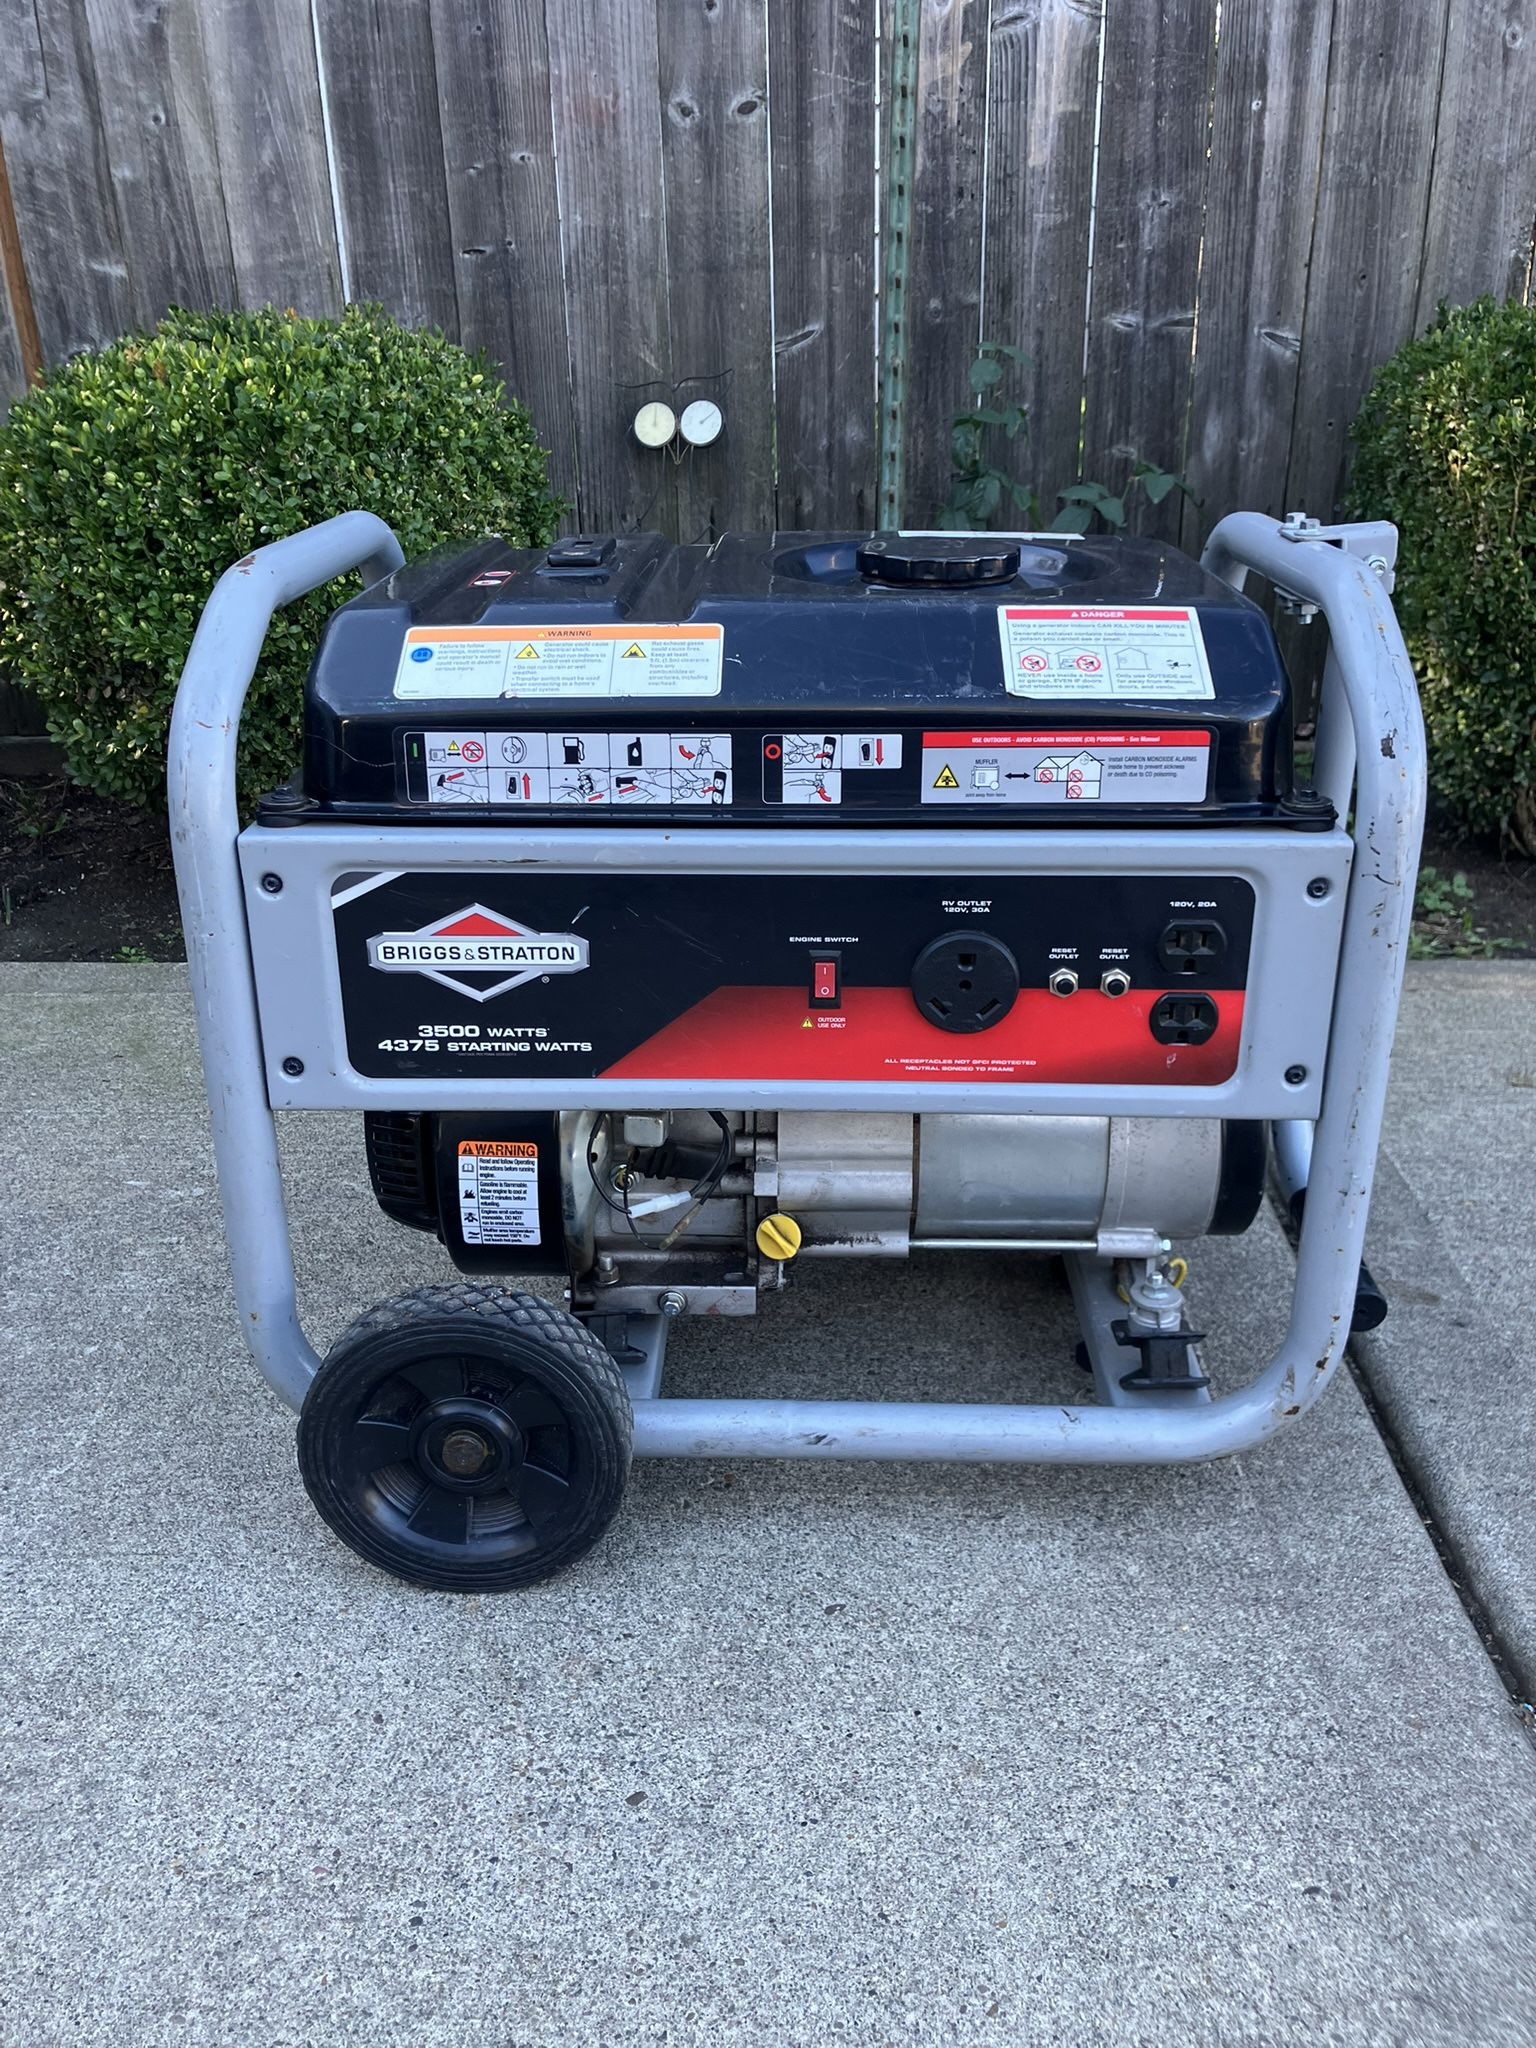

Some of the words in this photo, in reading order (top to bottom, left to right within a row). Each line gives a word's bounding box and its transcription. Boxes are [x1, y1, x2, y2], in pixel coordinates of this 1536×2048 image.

[418, 1025, 480, 1037] 3500
[378, 1039, 439, 1052] 4375
[447, 1042, 530, 1052] STARTING
[535, 1042, 593, 1052] WATTS
[475, 1143, 536, 1156] WARNING
